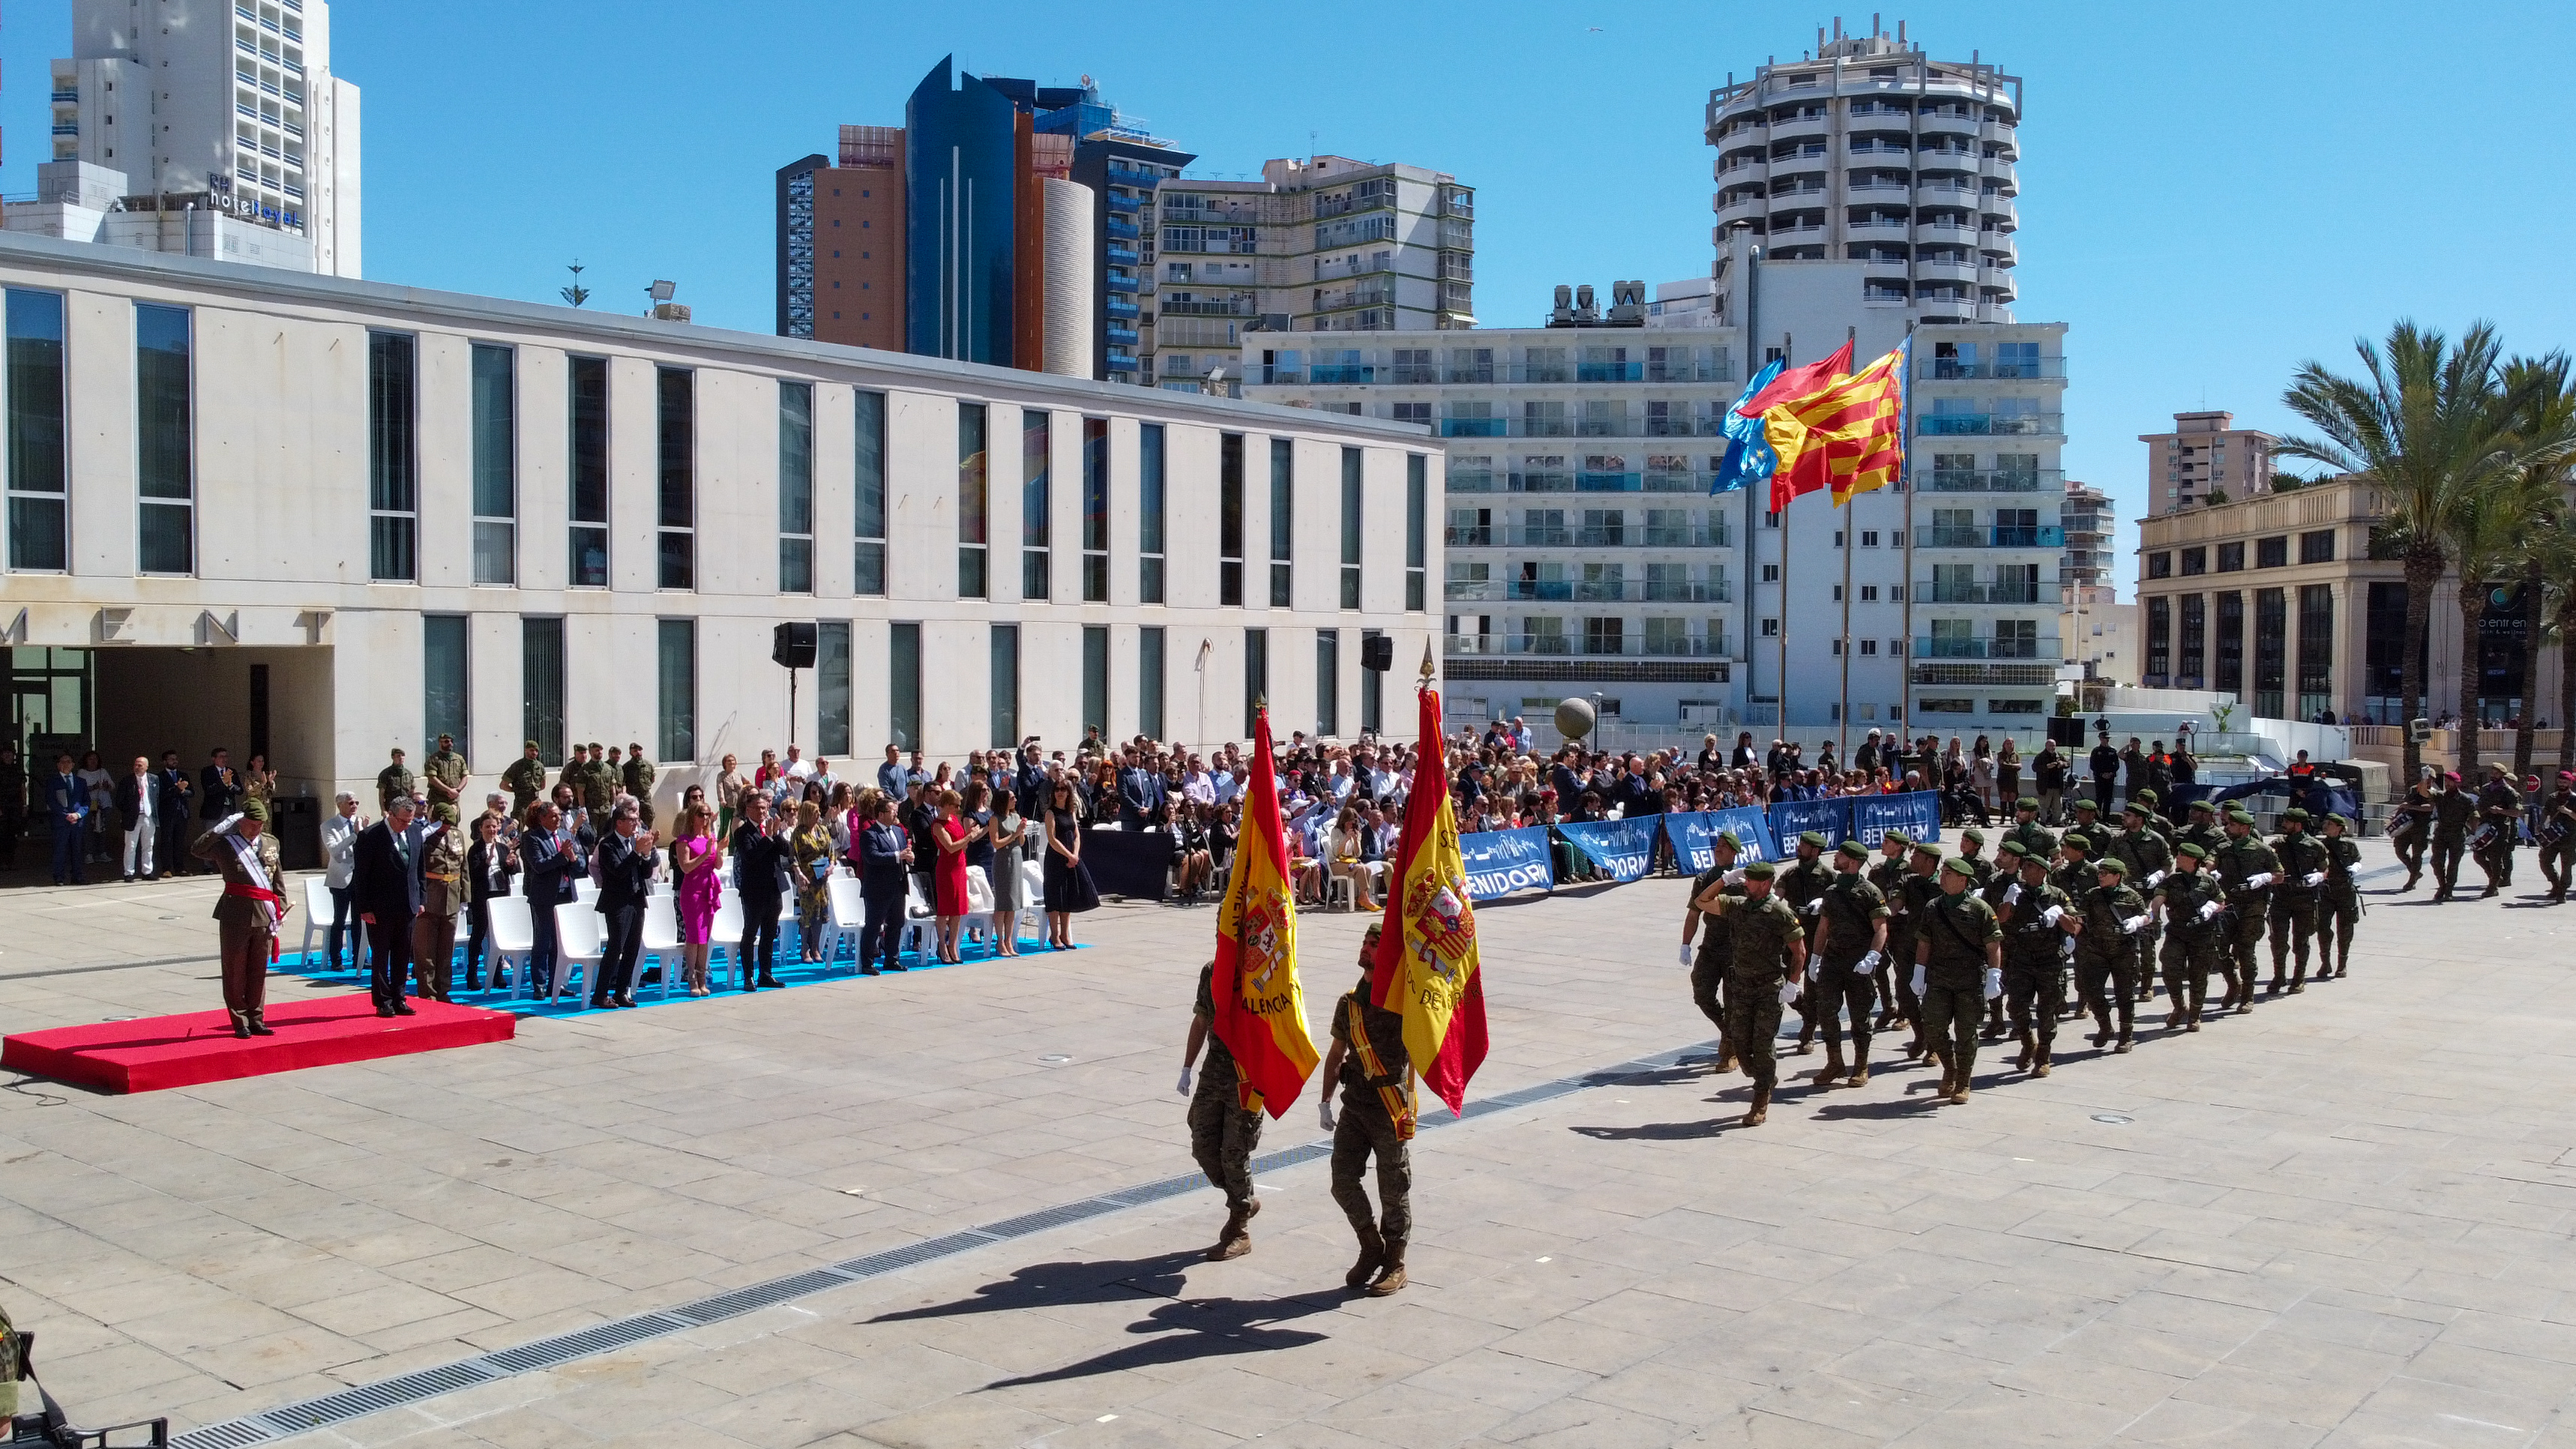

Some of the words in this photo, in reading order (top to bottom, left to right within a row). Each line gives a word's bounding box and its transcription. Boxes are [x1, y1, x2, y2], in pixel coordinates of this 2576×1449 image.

[210, 175, 229, 192] RH
[211, 188, 255, 214] hotel
[2512, 619, 2527, 627] en
[1242, 992, 1292, 1016] ALENCIA
